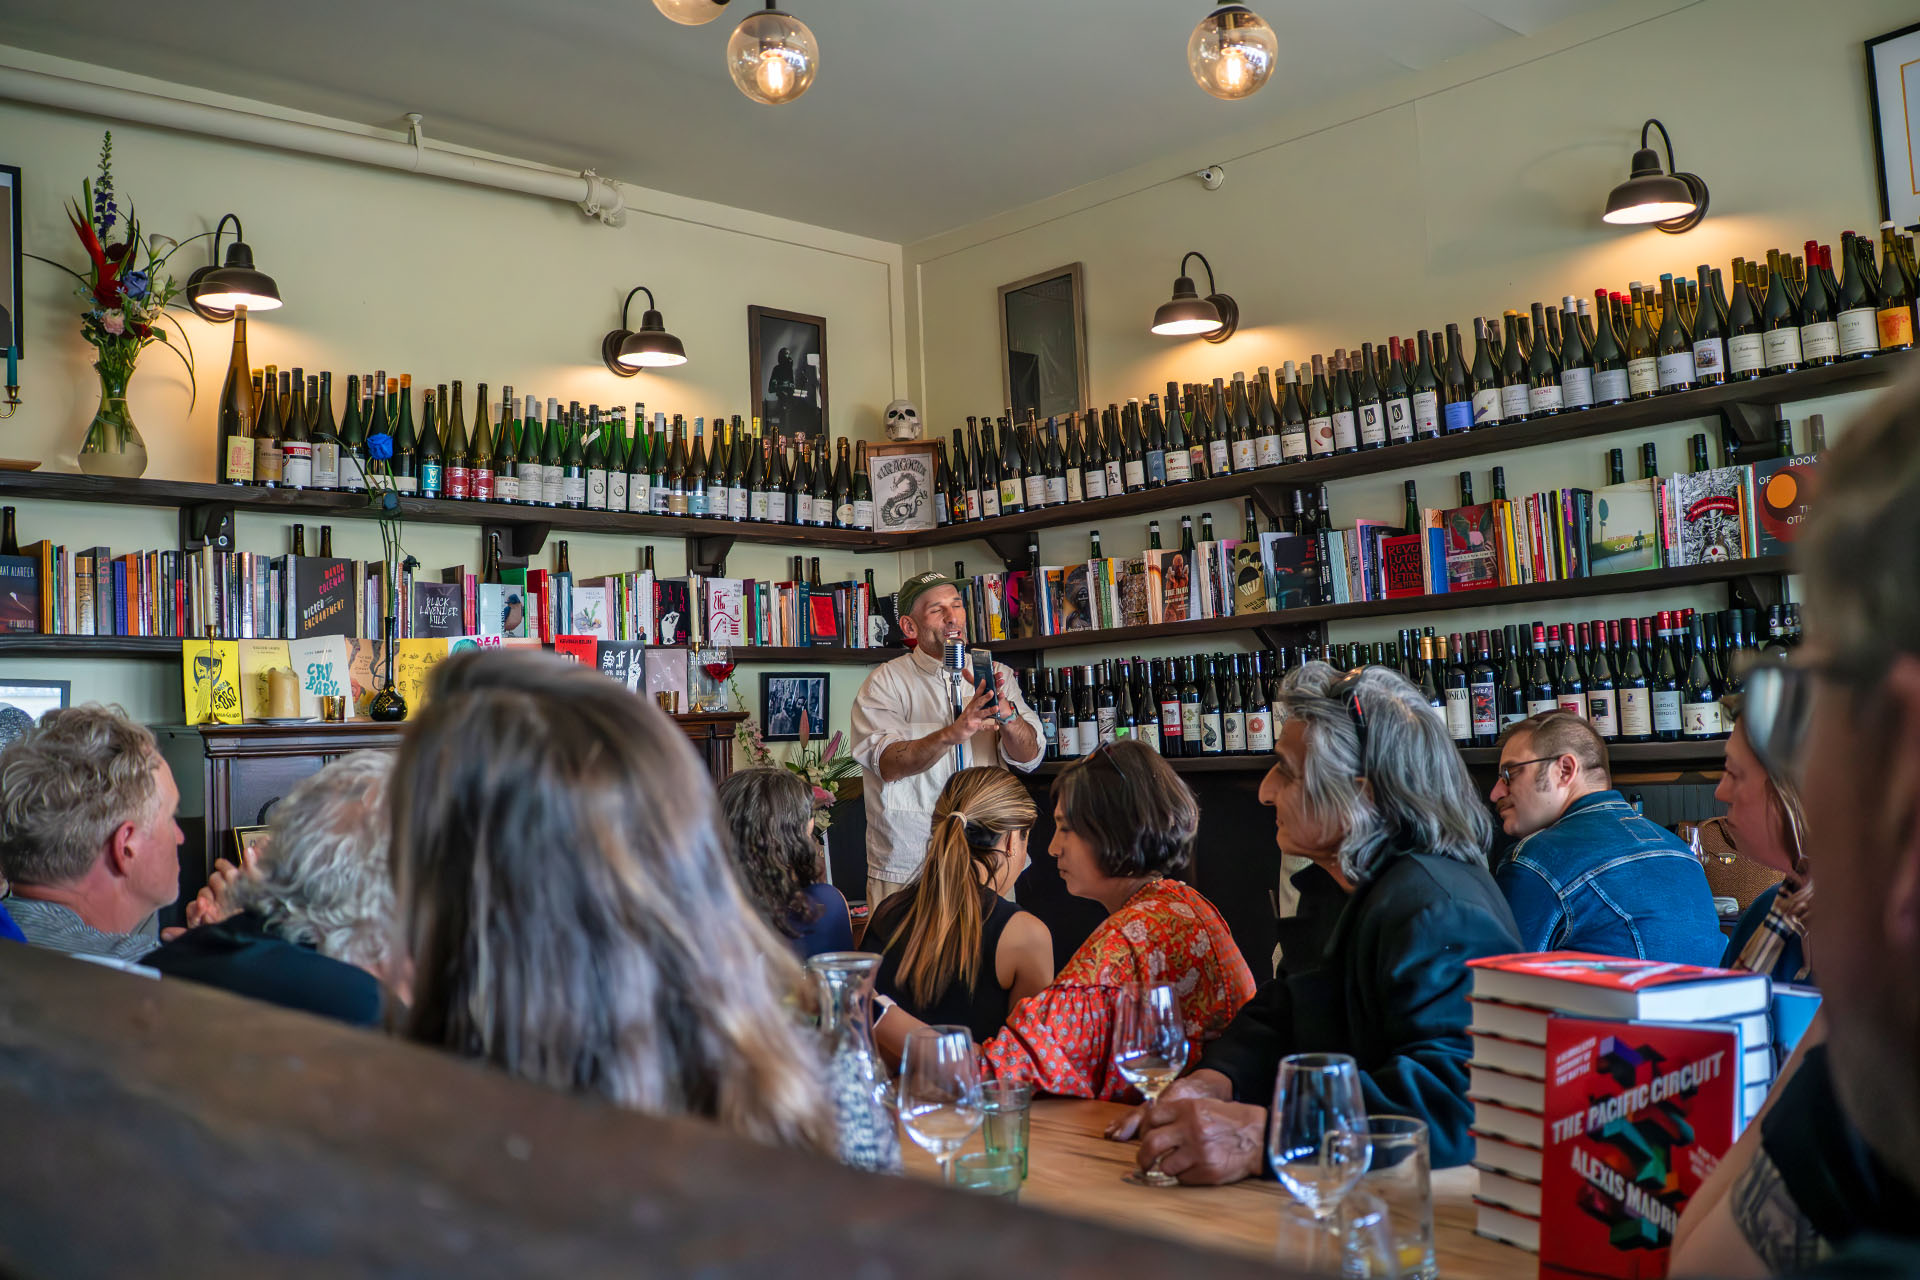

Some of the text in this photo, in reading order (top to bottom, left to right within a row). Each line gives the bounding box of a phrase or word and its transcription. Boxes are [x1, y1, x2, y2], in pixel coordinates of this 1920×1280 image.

[1789, 455, 1817, 467] BOOK
[1758, 475, 1771, 485] OF
[318, 572, 345, 595] COLEMAN
[303, 598, 325, 620] WICKED
[306, 662, 334, 682] CRY
[1552, 1050, 1726, 1145] THE PACIFIC CIRCUIT
[1570, 1145, 1625, 1202] ALEXIS
